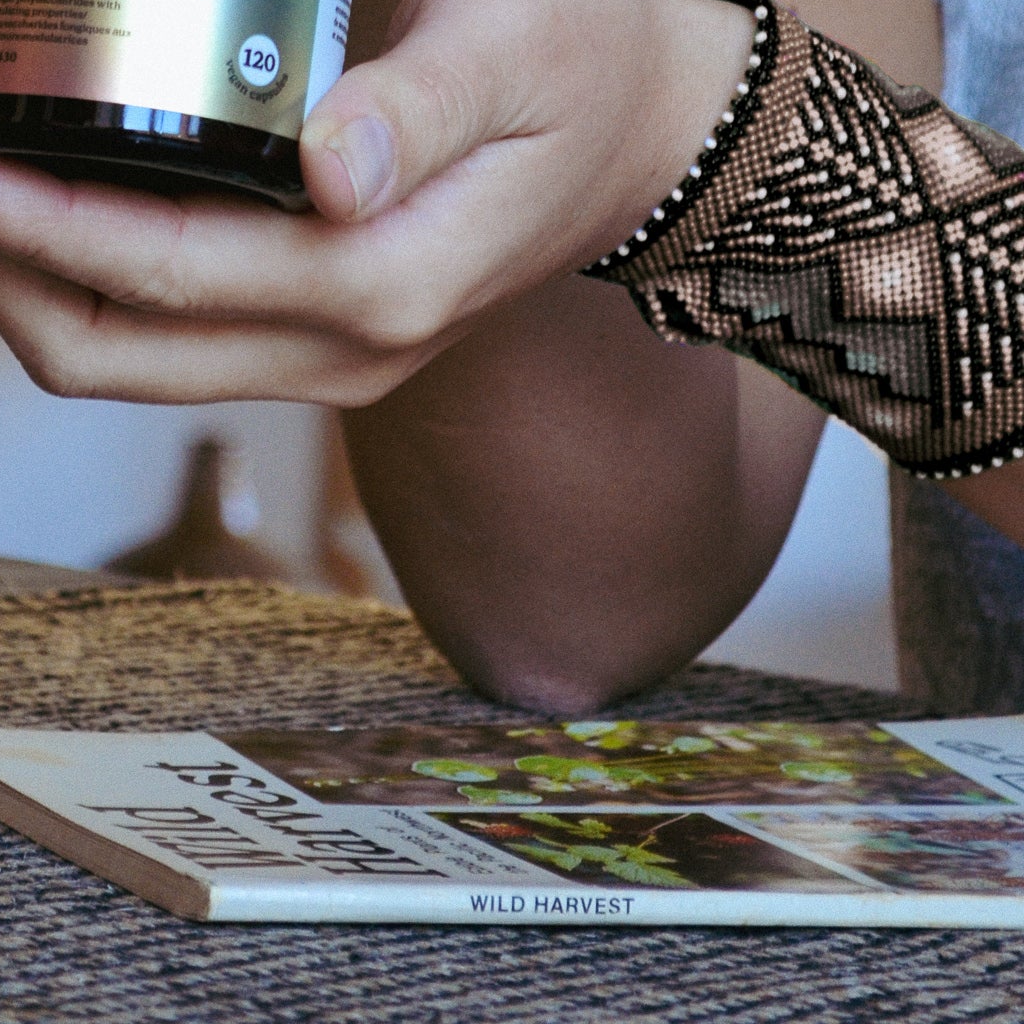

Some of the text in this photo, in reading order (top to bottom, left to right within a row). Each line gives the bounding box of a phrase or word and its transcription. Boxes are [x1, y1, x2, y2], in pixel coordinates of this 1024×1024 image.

[96, 0, 121, 10] with
[243, 48, 276, 72] 120
[226, 59, 249, 95] vegan
[143, 760, 451, 878] Harvest
[77, 804, 306, 869] Wild
[470, 895, 635, 915] WILD HARVEST
